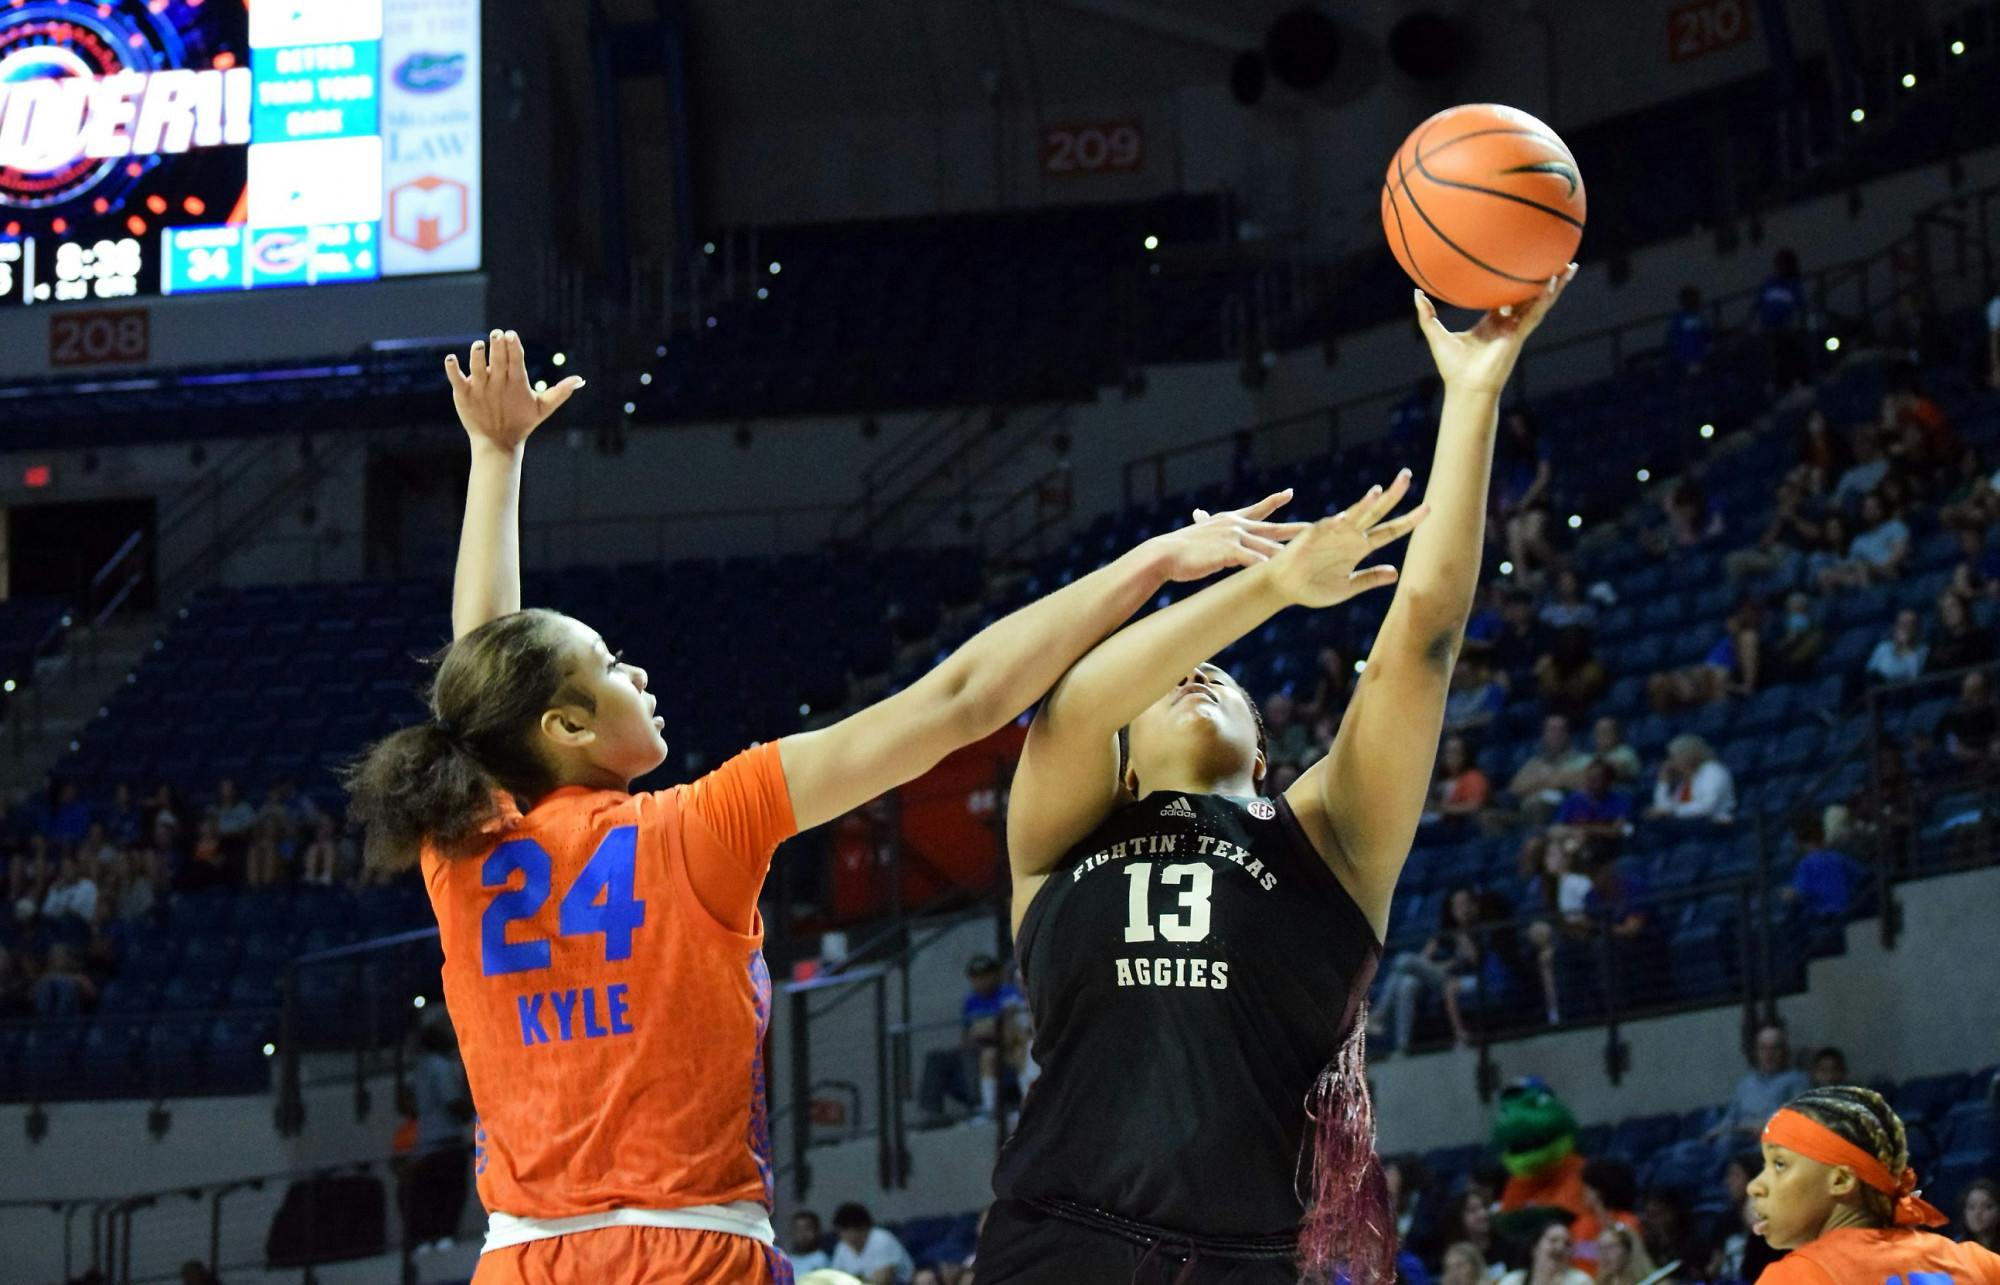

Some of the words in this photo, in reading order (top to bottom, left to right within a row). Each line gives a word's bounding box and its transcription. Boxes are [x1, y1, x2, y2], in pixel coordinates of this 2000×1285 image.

[1678, 1, 1741, 52] 210
[1047, 127, 1139, 171] 209
[188, 248, 229, 281] 34
[55, 318, 144, 359] 208
[1160, 808, 1197, 819] adidas
[1250, 803, 1273, 818] SEC
[1197, 834, 1278, 891] TEXAS
[481, 824, 646, 977] 24
[1123, 862, 1214, 943] 13
[1115, 957, 1229, 990] AGGIES
[517, 983, 634, 1047] KYLE
